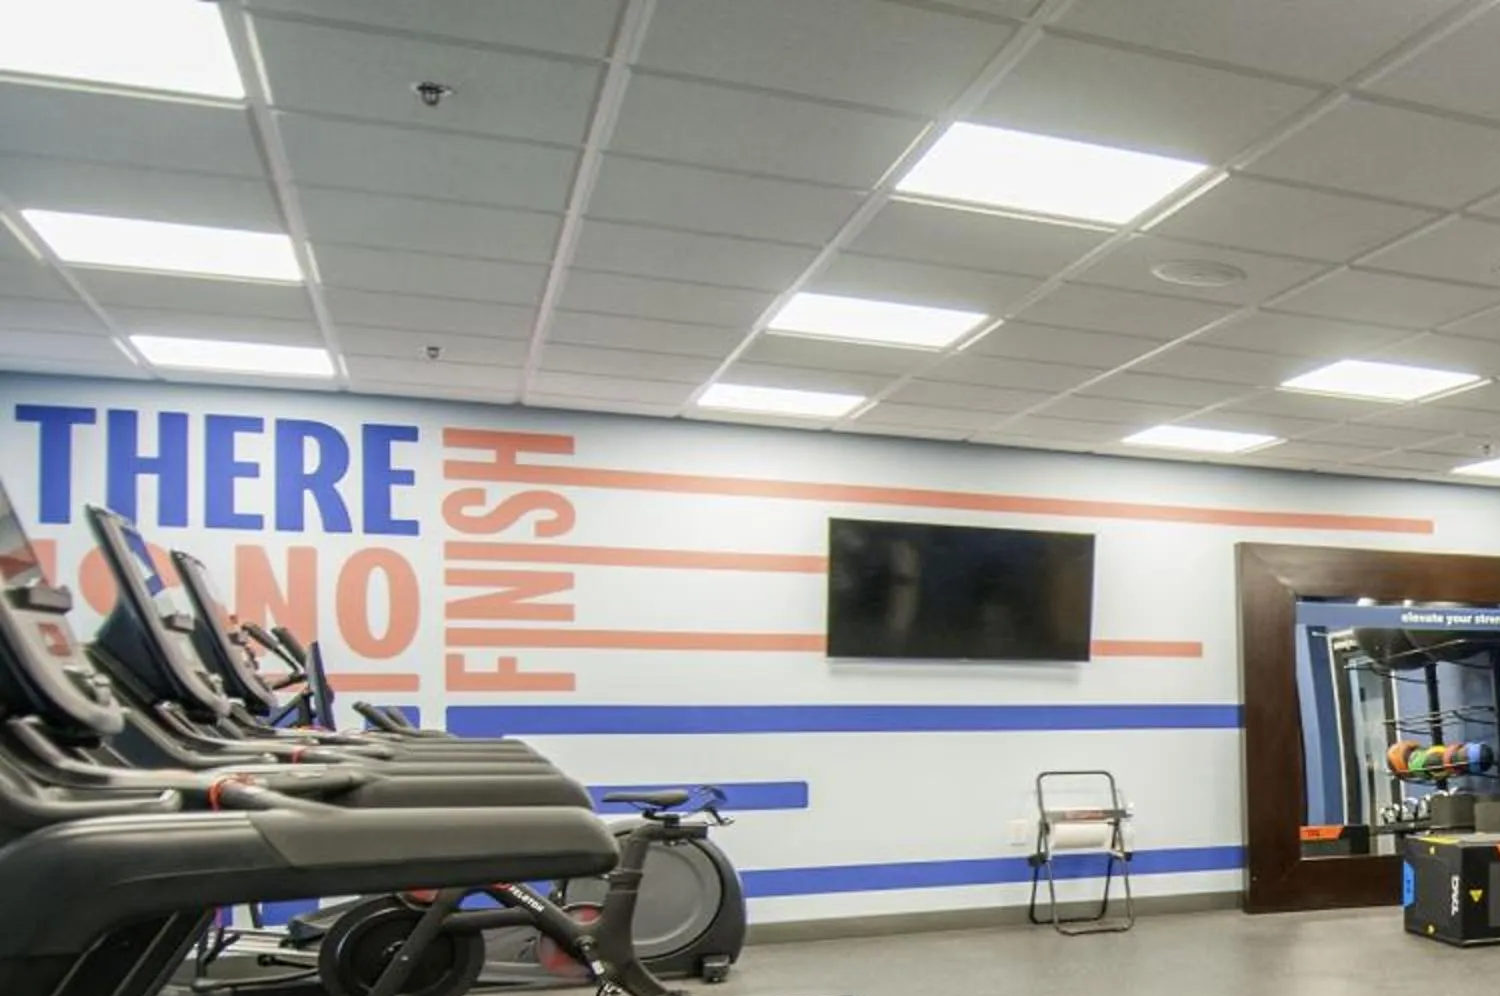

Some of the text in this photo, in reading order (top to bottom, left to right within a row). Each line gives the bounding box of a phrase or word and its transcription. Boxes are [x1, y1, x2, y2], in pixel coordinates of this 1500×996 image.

[15, 404, 420, 536] THERE
[234, 544, 420, 660] NO
[441, 427, 576, 692] FINISH
[1402, 612, 1445, 623] elevate
[1446, 614, 1473, 627] your
